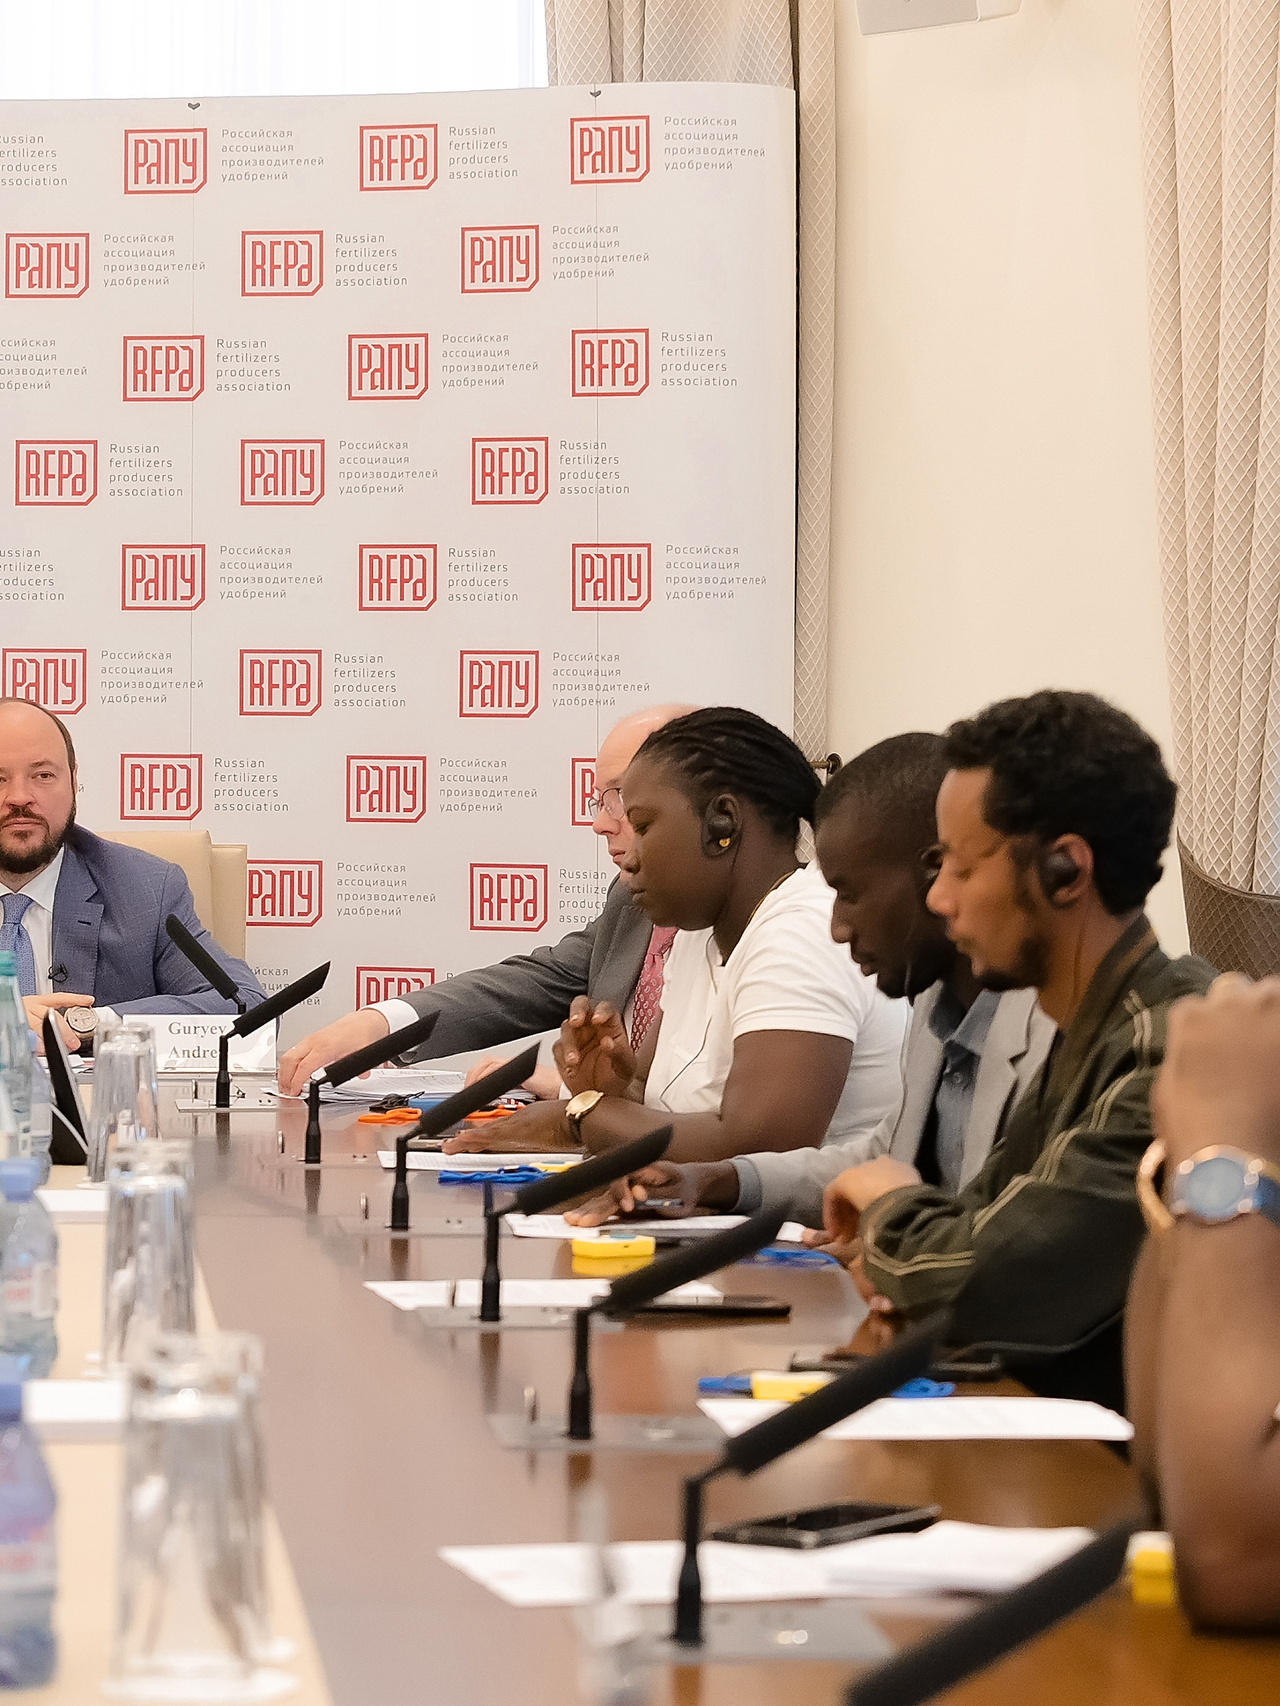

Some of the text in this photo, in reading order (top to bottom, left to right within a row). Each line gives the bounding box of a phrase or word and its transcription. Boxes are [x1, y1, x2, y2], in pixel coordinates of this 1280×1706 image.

[664, 116, 737, 127] Российская
[221, 128, 293, 139] Российская
[449, 125, 496, 137] Russian
[664, 132, 738, 142] ассоциация
[221, 144, 294, 153] ассоциация
[448, 139, 508, 151] fertilizers
[664, 146, 766, 158] производителей
[221, 156, 324, 169] производителей
[448, 154, 509, 168] producers
[664, 159, 733, 172] удобрений
[221, 171, 288, 183] удобрений
[448, 167, 519, 180] association
[103, 233, 175, 244] Российская
[335, 233, 385, 244] Russian
[103, 249, 176, 258] ассоциация
[335, 247, 398, 258] fertilizers
[103, 259, 206, 274] производителей
[335, 261, 398, 275] producers
[103, 275, 170, 288] удобрений
[335, 275, 408, 287] association
[442, 333, 509, 344] Российская
[661, 331, 713, 342] Russian
[216, 338, 267, 349] Russian
[216, 352, 280, 363] fertilizers
[441, 349, 510, 359] ассоциация
[660, 345, 727, 358] fertilizers
[216, 366, 281, 380] producers
[441, 361, 539, 374] производителей
[661, 360, 727, 374] producers
[215, 381, 291, 392] association
[441, 376, 505, 390] удобрений
[660, 375, 738, 387] association
[109, 443, 160, 454] Russian
[339, 440, 409, 451] Российская
[109, 457, 173, 468] fertilizers
[338, 456, 410, 466] ассоциация
[109, 471, 173, 485] producers
[338, 468, 438, 481] производителей
[108, 486, 183, 497] association
[338, 483, 404, 496] удобрений
[219, 545, 292, 556] Российская
[448, 547, 496, 558] Russian
[665, 544, 739, 555] Российская
[219, 561, 293, 571] ассоциация
[447, 561, 509, 573] fertilizers
[665, 561, 740, 571] ассоциация
[219, 574, 323, 586] производителей
[447, 576, 509, 589] producers
[665, 575, 767, 586] производителей
[219, 588, 287, 601] удобрений
[447, 591, 519, 602] association
[665, 588, 735, 601] удобрений
[334, 653, 384, 664] Russian
[333, 667, 396, 679] fertilizers
[333, 682, 397, 695] producers
[333, 696, 406, 708] association
[214, 757, 265, 769] Russian
[439, 757, 507, 768] Российская
[213, 771, 278, 783] fertilizers
[439, 774, 509, 784] ассоциация
[213, 786, 279, 799] producers
[439, 788, 538, 799] производителей
[213, 801, 289, 812] association
[439, 801, 503, 814] удобрений
[337, 861, 406, 873] Российская
[559, 868, 607, 880] Russian
[336, 878, 407, 888] ассоциация
[336, 892, 436, 903] производителей
[336, 905, 402, 918] удобрений
[168, 1021, 228, 1038] Guryev
